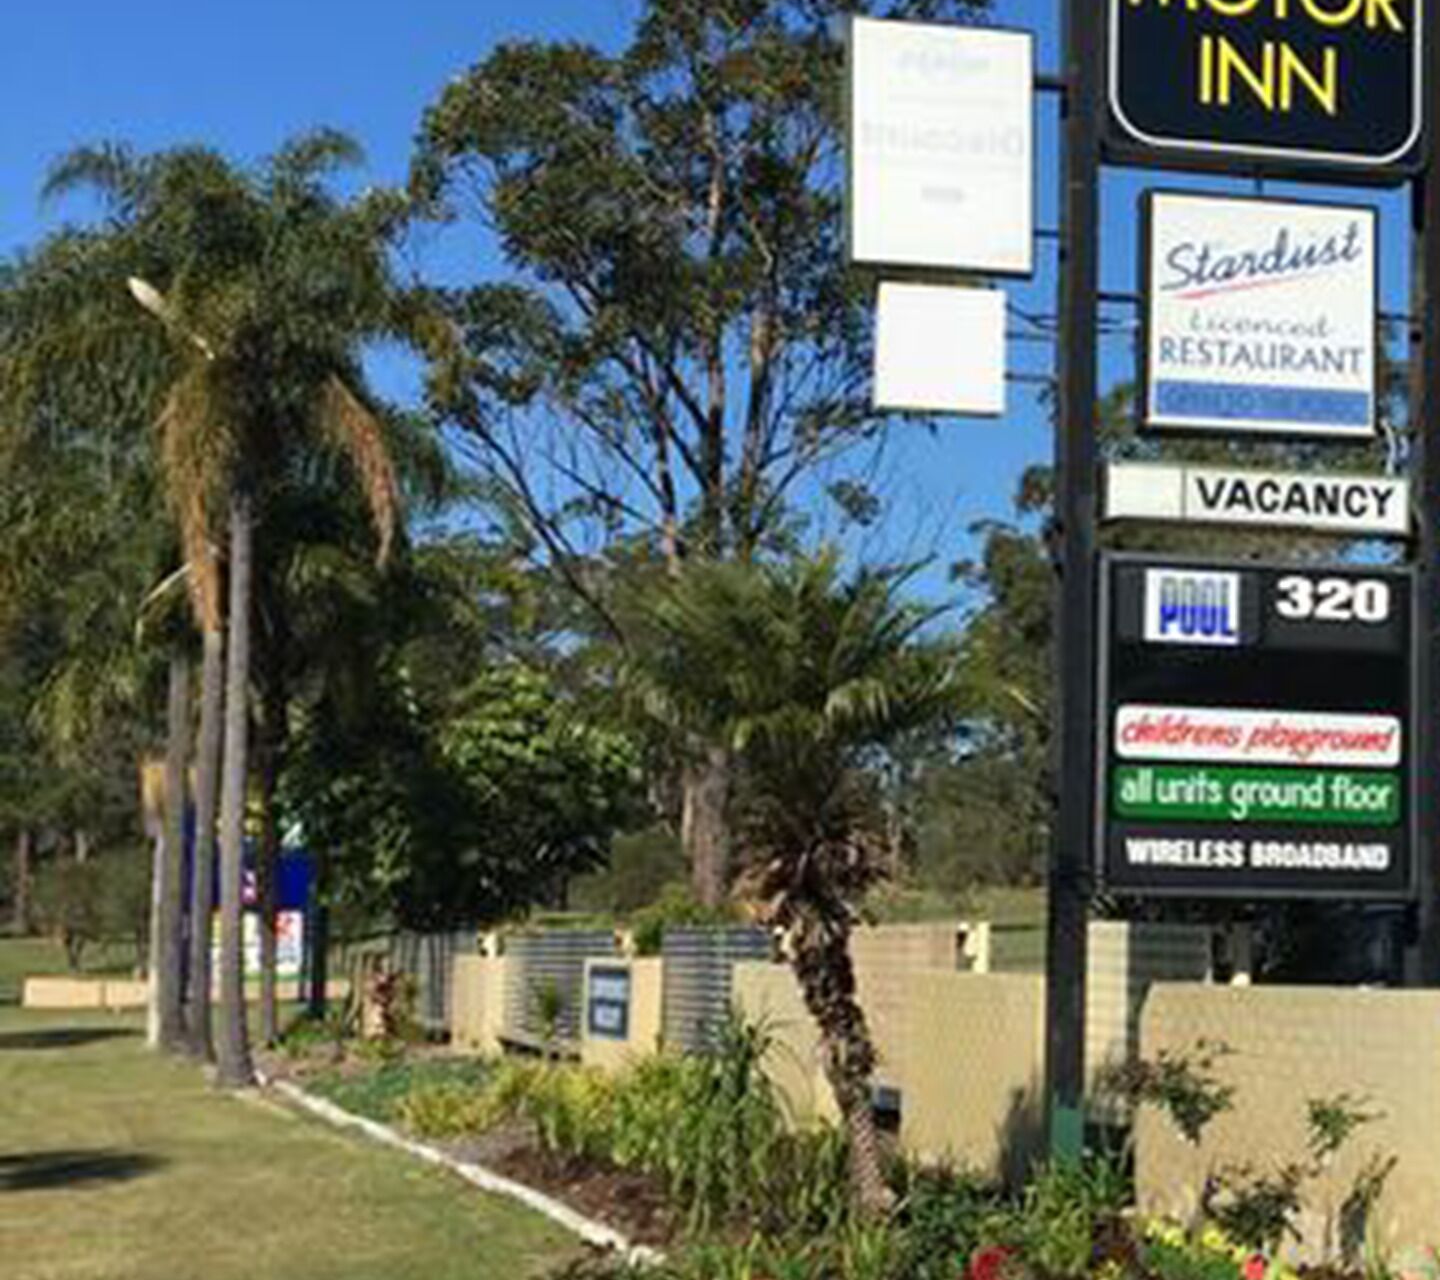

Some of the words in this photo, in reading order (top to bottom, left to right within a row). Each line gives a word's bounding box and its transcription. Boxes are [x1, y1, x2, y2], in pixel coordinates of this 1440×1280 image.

[1200, 35, 1338, 115] INN
[1160, 221, 1364, 291] Stardust
[1159, 335, 1365, 375] RESTAURANT
[1197, 477, 1394, 518] VACANCY
[1158, 577, 1236, 637] POOL
[1276, 575, 1390, 621] 320
[1121, 716, 1243, 748] childrens
[1244, 720, 1395, 759] playground
[1121, 770, 1154, 803] all
[1156, 774, 1222, 804] units
[1230, 775, 1324, 820] ground
[1329, 776, 1391, 810] floor
[1125, 838, 1244, 867] WIRELESS
[1251, 841, 1390, 870] BROADBAND
